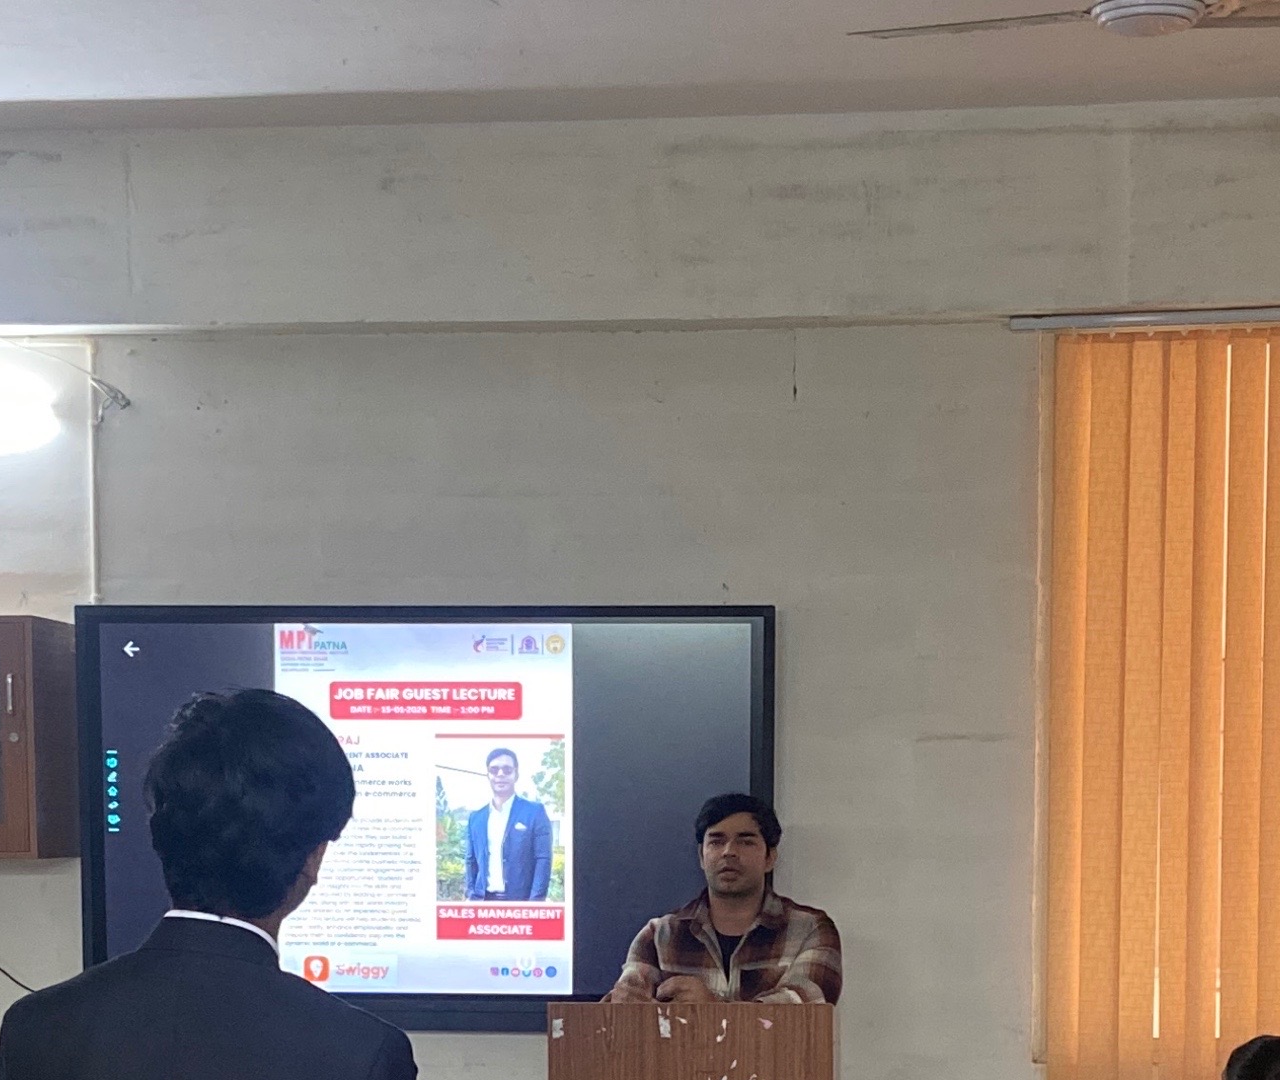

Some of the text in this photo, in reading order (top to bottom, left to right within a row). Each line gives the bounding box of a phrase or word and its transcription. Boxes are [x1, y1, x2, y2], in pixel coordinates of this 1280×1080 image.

[313, 641, 348, 650] PATNA
[334, 687, 516, 701] JOB FAIR GUEST LECTURE
[350, 705, 372, 714] DATE
[431, 705, 451, 714] TIME
[481, 705, 494, 714] PM
[364, 790, 417, 798] e-commerce
[438, 907, 563, 920] SALES MANAGEMENT
[467, 924, 533, 936] ASSOCIATE
[335, 962, 390, 980] Swiggy
